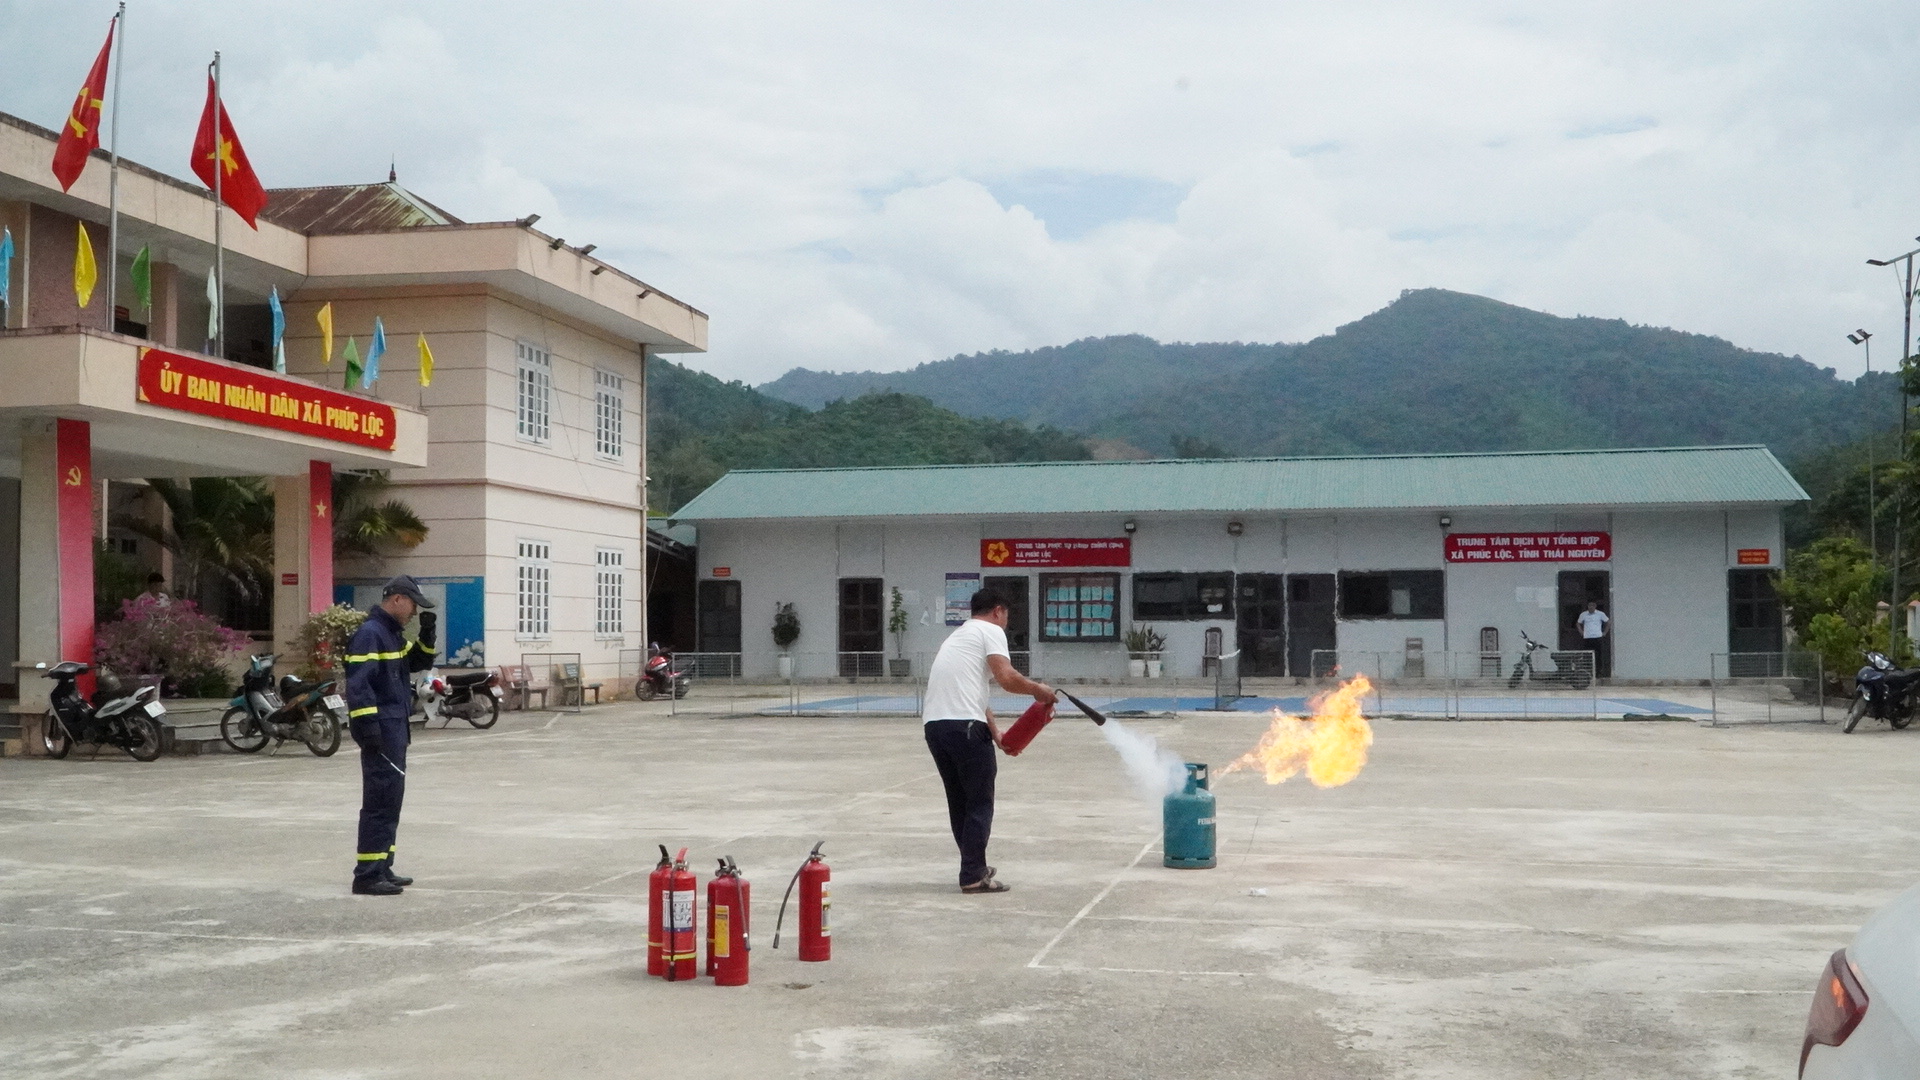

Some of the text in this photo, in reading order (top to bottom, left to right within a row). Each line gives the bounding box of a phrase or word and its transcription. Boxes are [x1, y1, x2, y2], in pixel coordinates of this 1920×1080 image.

[160, 361, 384, 440] ỦY BAN NHÂN DÂN XÃ PHÚC LỘC
[1457, 537, 1486, 546] TRUNG
[1490, 536, 1510, 546] TÂM
[1513, 537, 1534, 547] DỊCH
[1537, 537, 1550, 547] VỤ
[1451, 549, 1464, 559] XÃ
[1467, 549, 1491, 559] PHÚC
[1543, 548, 1564, 558] THÁI
[1568, 548, 1605, 558] NGUYÊN
